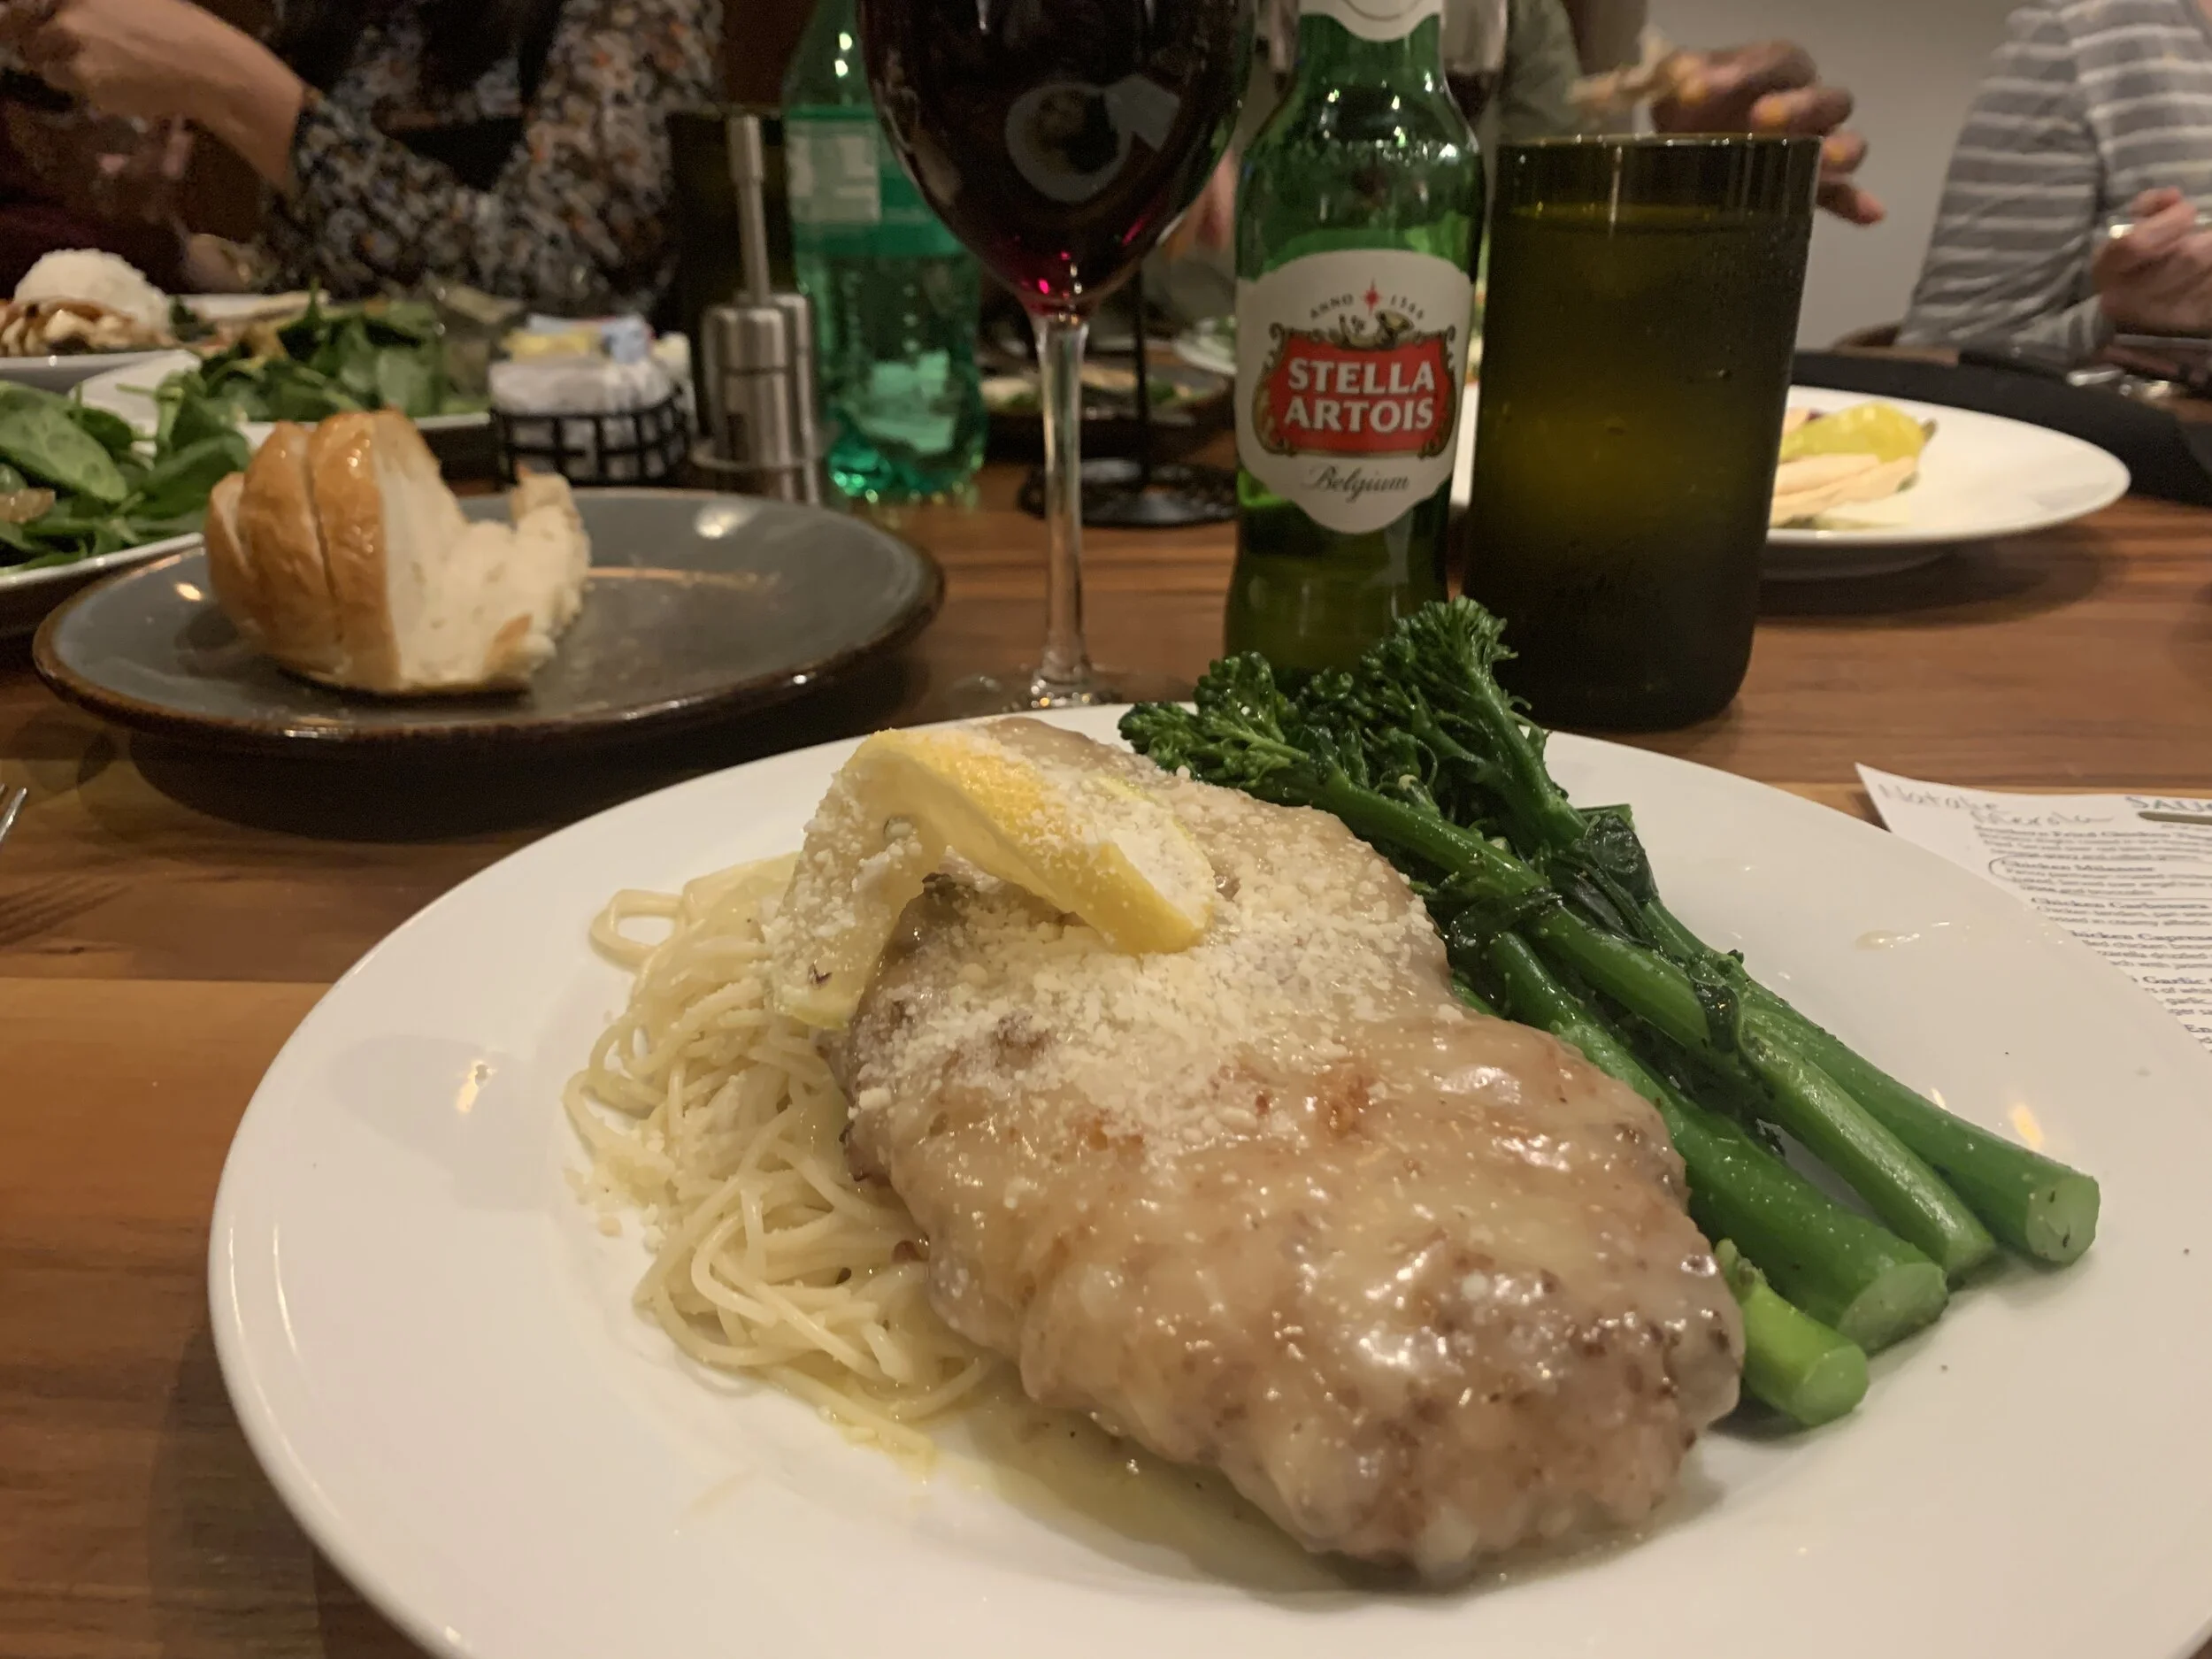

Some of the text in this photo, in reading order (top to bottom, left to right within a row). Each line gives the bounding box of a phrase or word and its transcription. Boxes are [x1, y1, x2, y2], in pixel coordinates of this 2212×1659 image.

[1310, 293, 1355, 320] ANNO
[1287, 357, 1435, 395] STELLA
[1285, 396, 1433, 433] ARTOIS
[1303, 465, 1409, 504] Belgium
[2071, 931, 2134, 941] hicken
